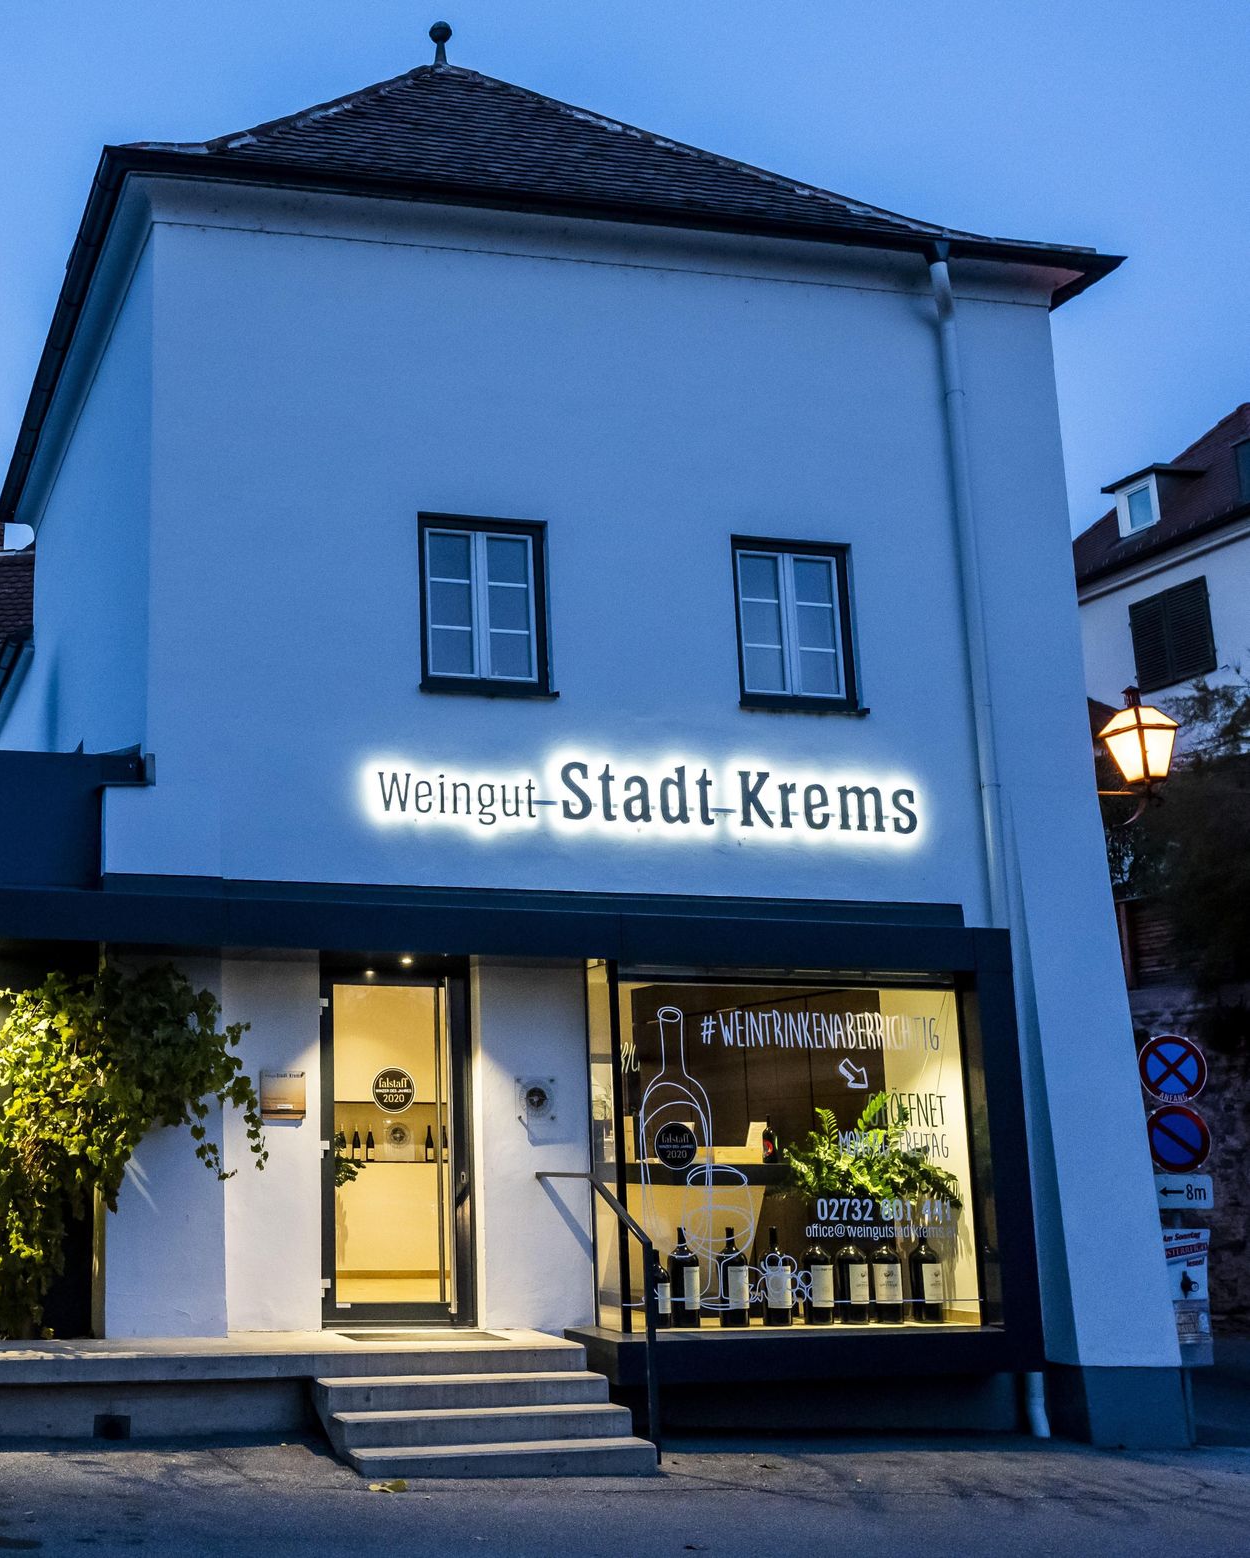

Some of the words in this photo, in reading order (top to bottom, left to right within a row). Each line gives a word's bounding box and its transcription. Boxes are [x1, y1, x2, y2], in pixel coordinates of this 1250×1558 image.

[376, 770, 538, 826] Weingut
[559, 760, 717, 826] Stadt
[737, 769, 918, 835] Krems
[378, 1077, 409, 1088] falstaff
[382, 1094, 405, 1103] 2020
[1159, 1091, 1188, 1102] ANFANG
[661, 1132, 690, 1144] falstaff
[666, 1150, 688, 1159] 2020
[1185, 1183, 1207, 1201] 8m
[816, 1197, 874, 1221] 02732
[880, 1197, 912, 1222] 801
